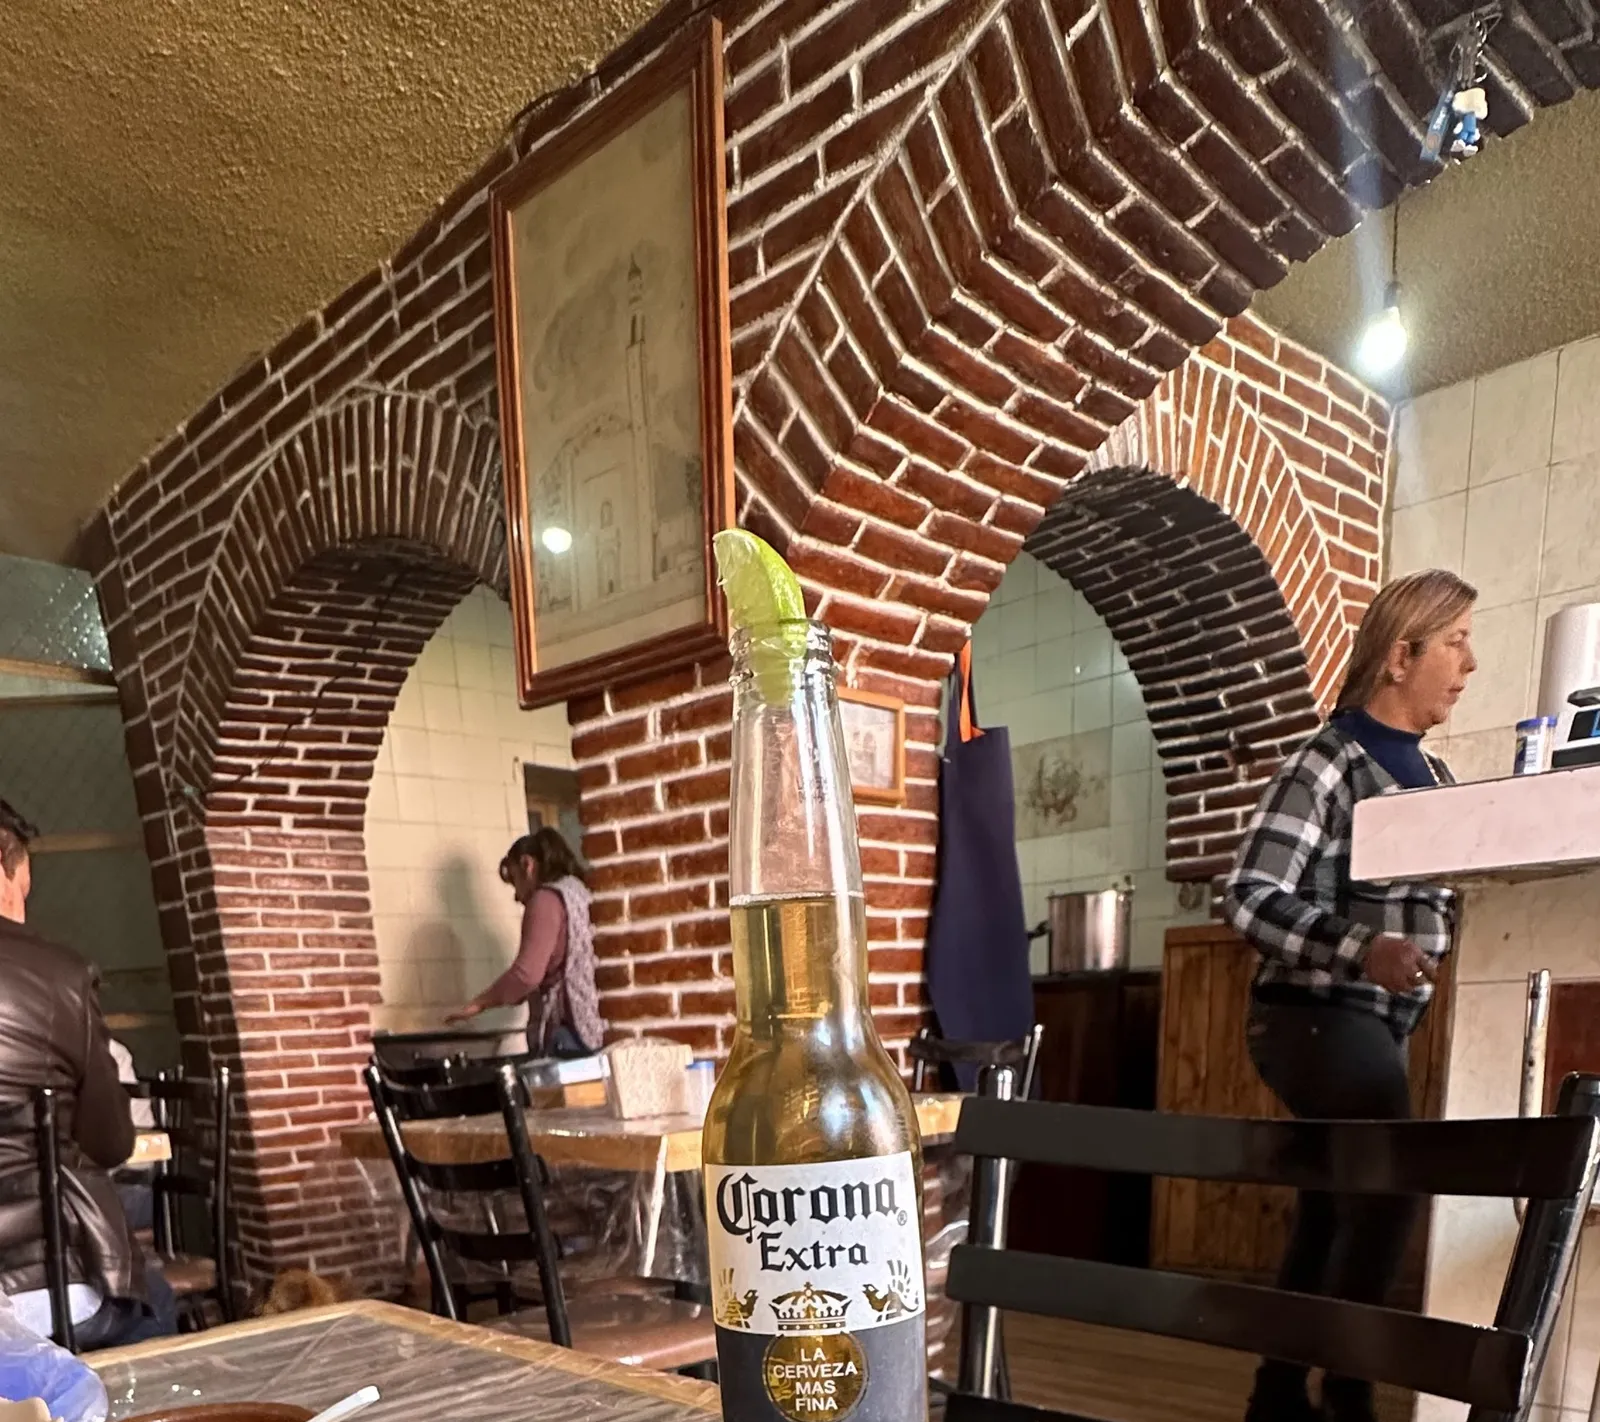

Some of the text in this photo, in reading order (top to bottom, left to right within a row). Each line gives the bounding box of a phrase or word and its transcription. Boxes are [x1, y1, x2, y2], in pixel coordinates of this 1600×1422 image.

[716, 1172, 899, 1244] Corona
[757, 1231, 869, 1272] Extra
[800, 1347, 826, 1362] LA
[773, 1361, 858, 1379] CERVEZA
[795, 1380, 836, 1395] MAS
[795, 1397, 838, 1412] FINA
